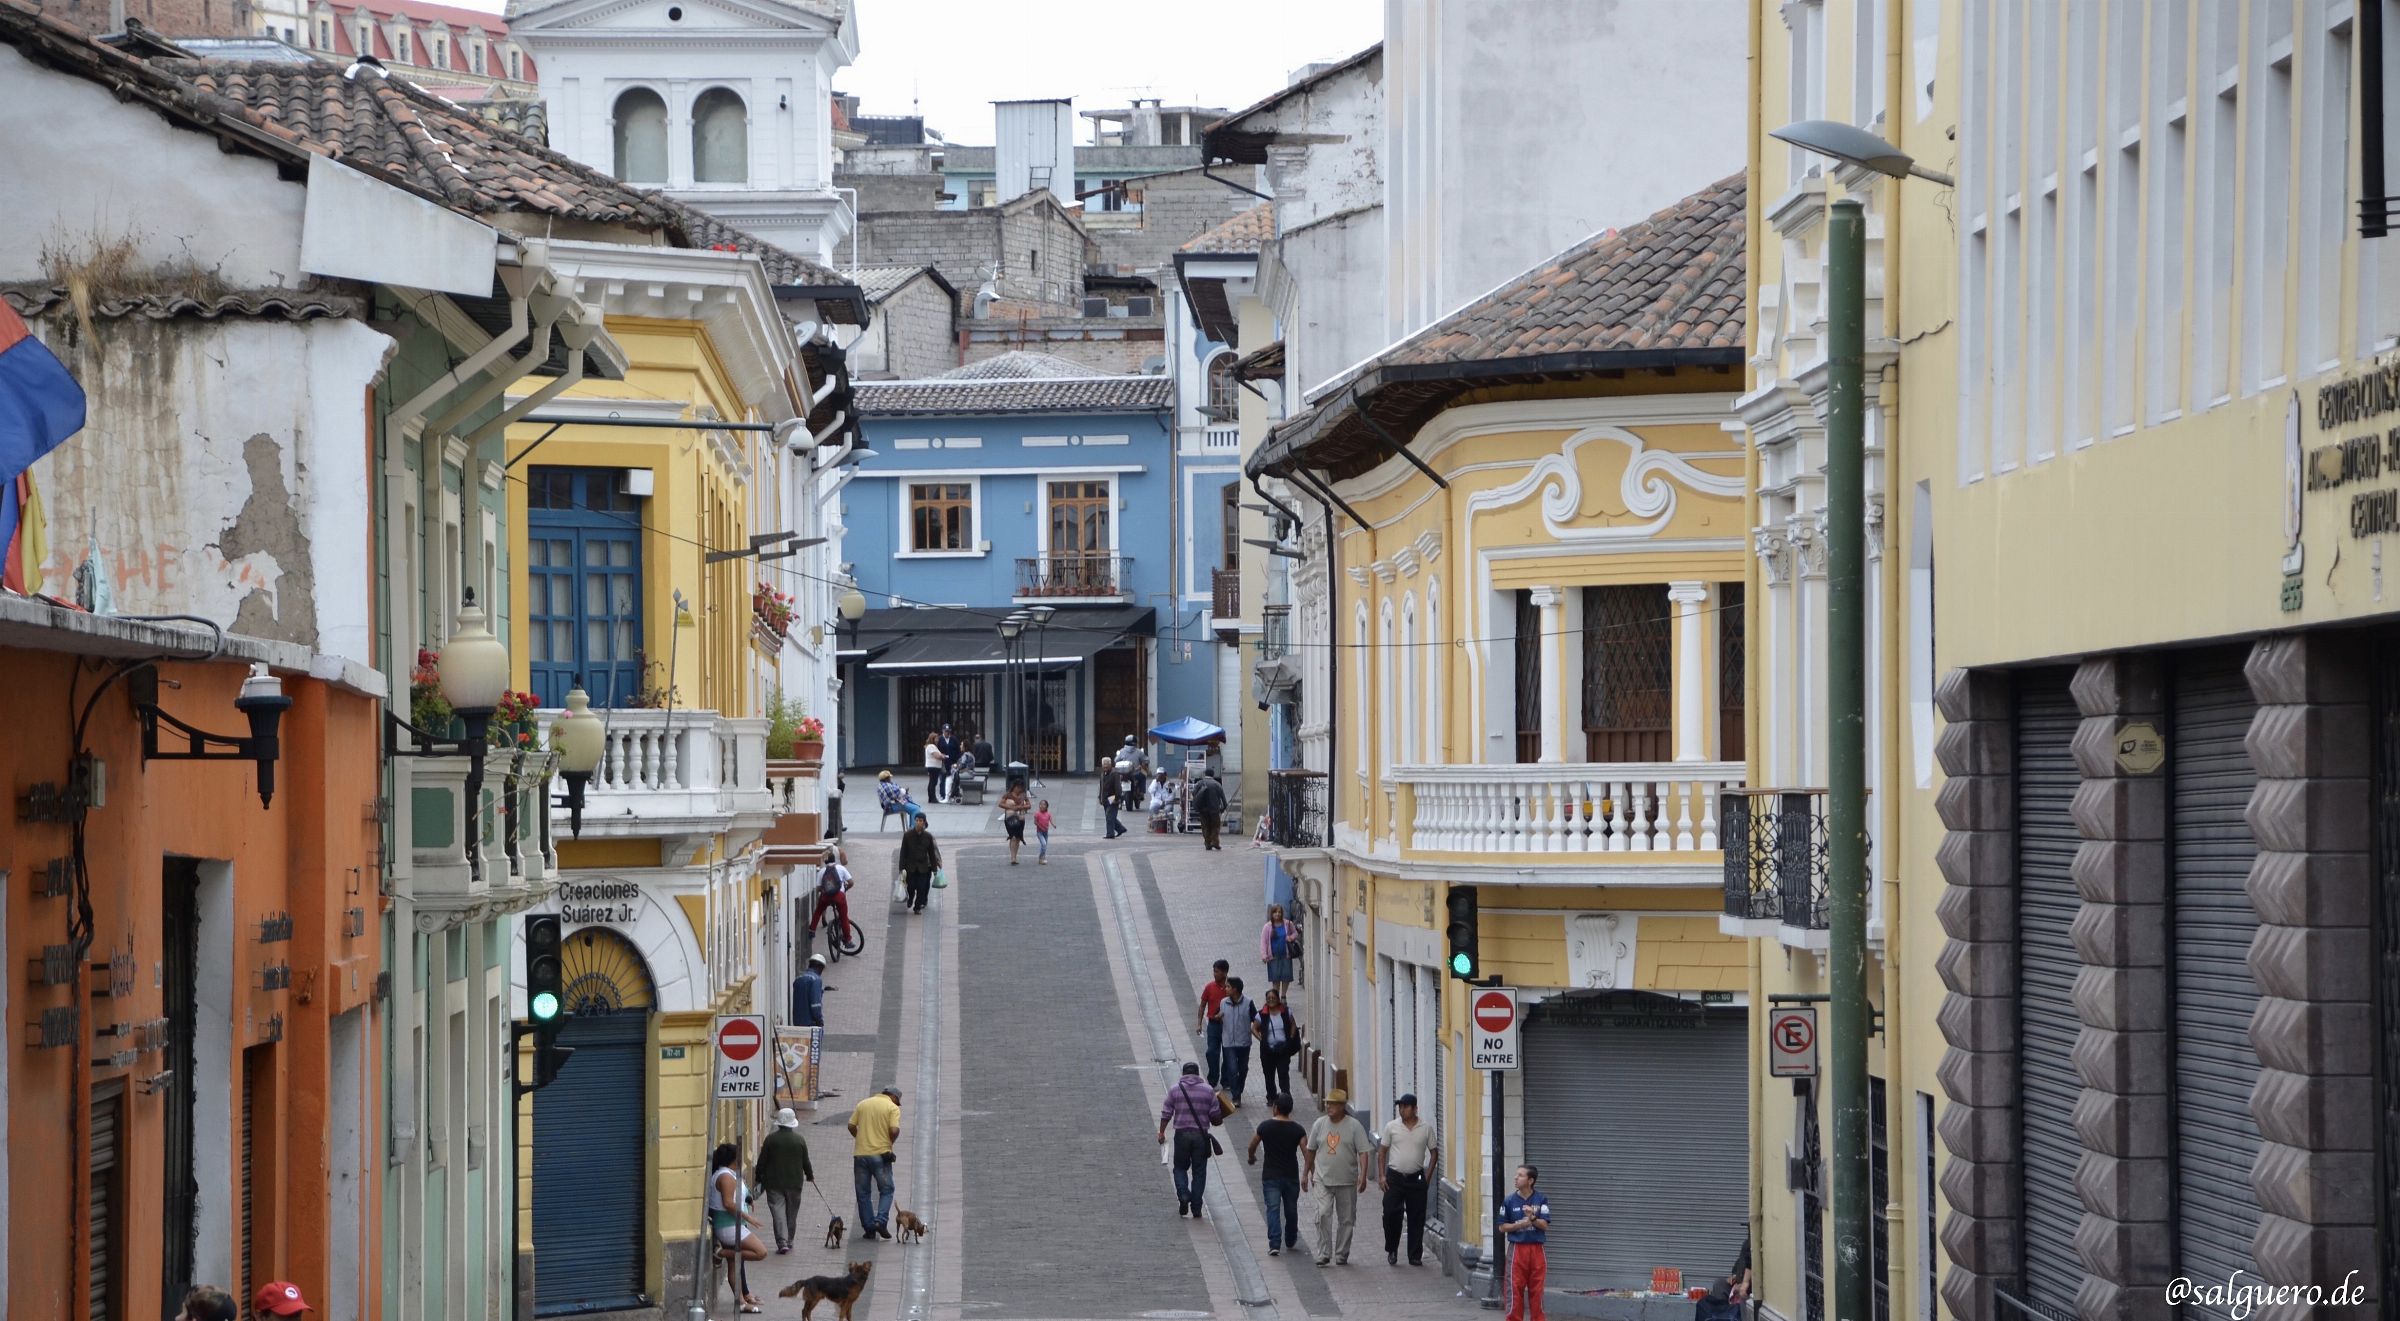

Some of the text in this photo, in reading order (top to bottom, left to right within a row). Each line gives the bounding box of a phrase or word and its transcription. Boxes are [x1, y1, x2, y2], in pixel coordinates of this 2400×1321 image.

[2319, 377, 2360, 430] CENTRO
[2351, 488, 2400, 538] CENTRAL
[559, 880, 639, 901] Creaciones
[562, 903, 637, 923] Suárez Jr.
[1484, 1038, 1503, 1050] NO
[1477, 1054, 1513, 1064] ENTRE
[730, 1065, 750, 1078] NO
[721, 1082, 760, 1092] ENTRE
